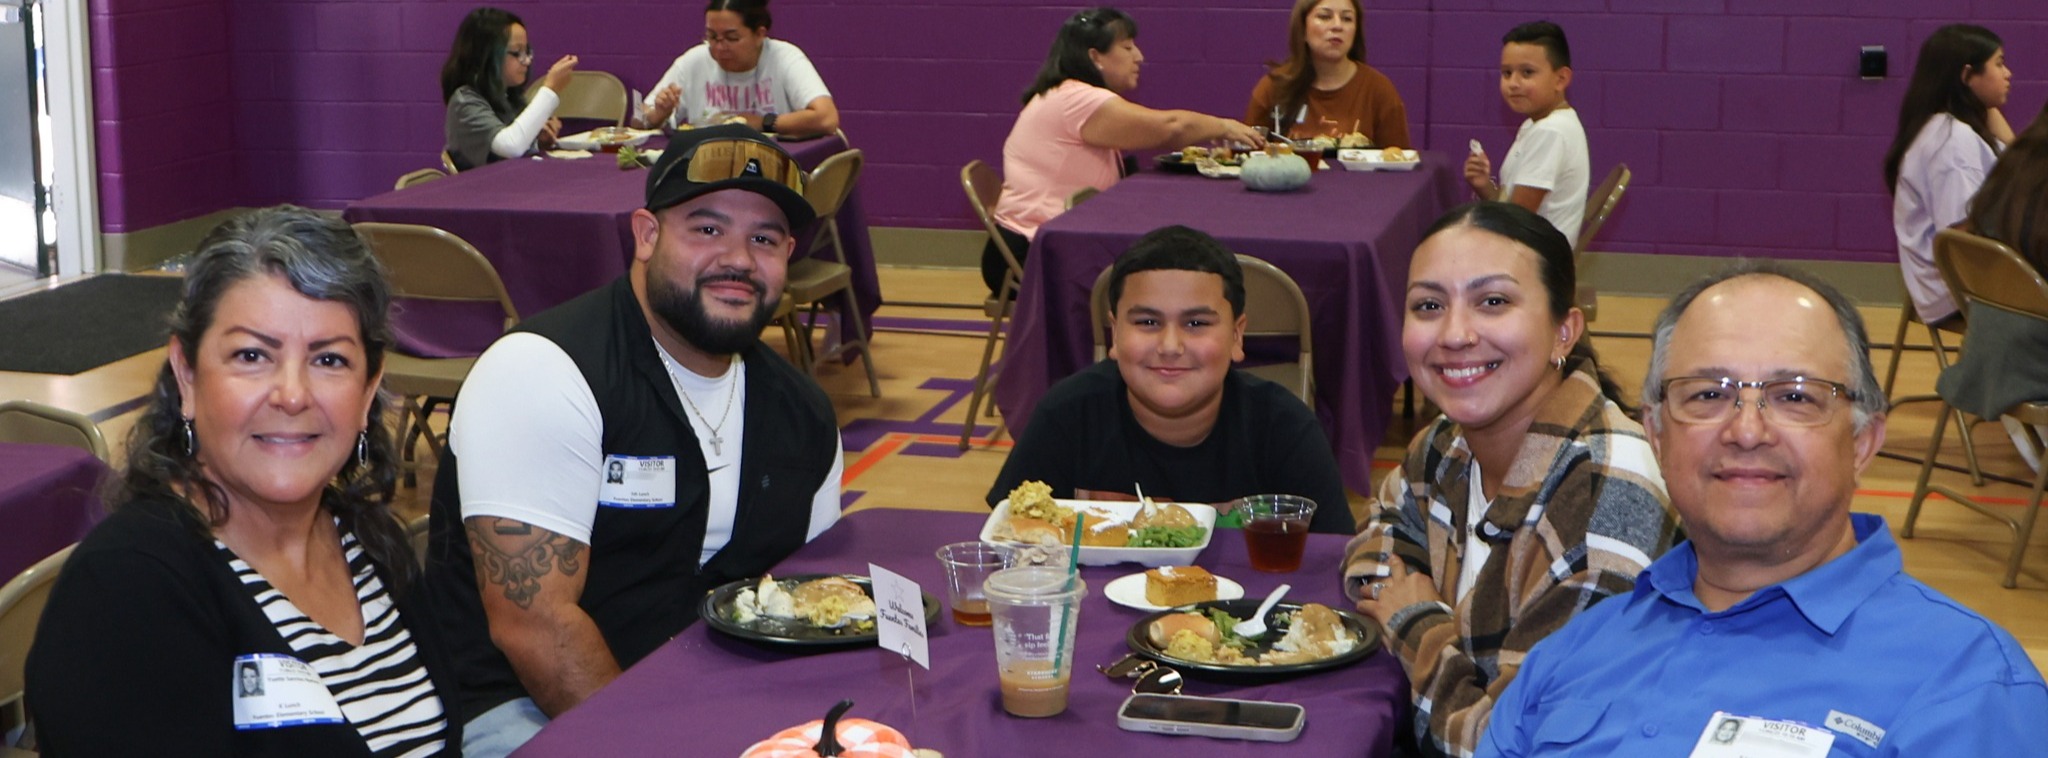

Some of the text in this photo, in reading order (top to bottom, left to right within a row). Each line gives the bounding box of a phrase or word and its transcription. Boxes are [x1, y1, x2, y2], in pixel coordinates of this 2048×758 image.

[640, 460, 665, 468] VISITOR
[1025, 642, 1036, 650] sip
[276, 710, 308, 718] Elementary
[1763, 721, 1807, 737] VISITOR
